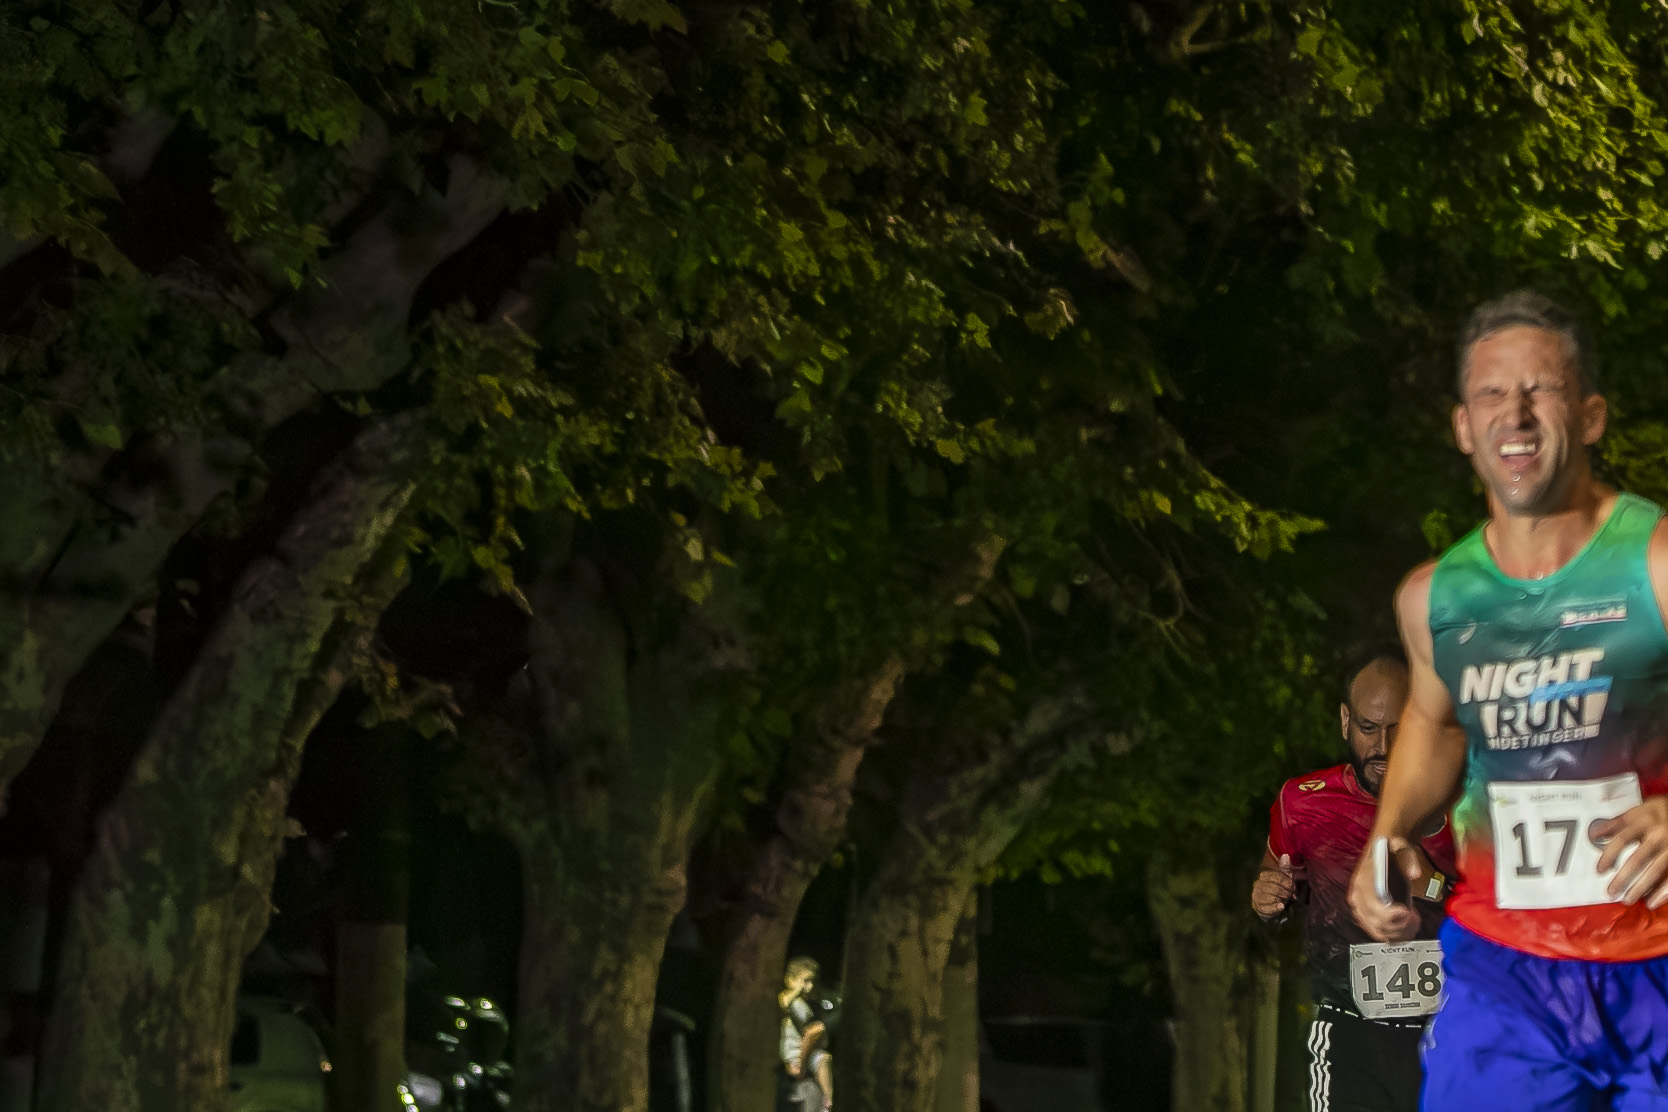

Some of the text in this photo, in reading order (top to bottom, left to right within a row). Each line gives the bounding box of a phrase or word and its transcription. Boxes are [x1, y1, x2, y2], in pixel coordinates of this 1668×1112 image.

[1460, 648, 1606, 704] NIGHT
[1481, 692, 1609, 739] RUN
[1512, 819, 1612, 878] 17
[1360, 961, 1442, 1001] 148
